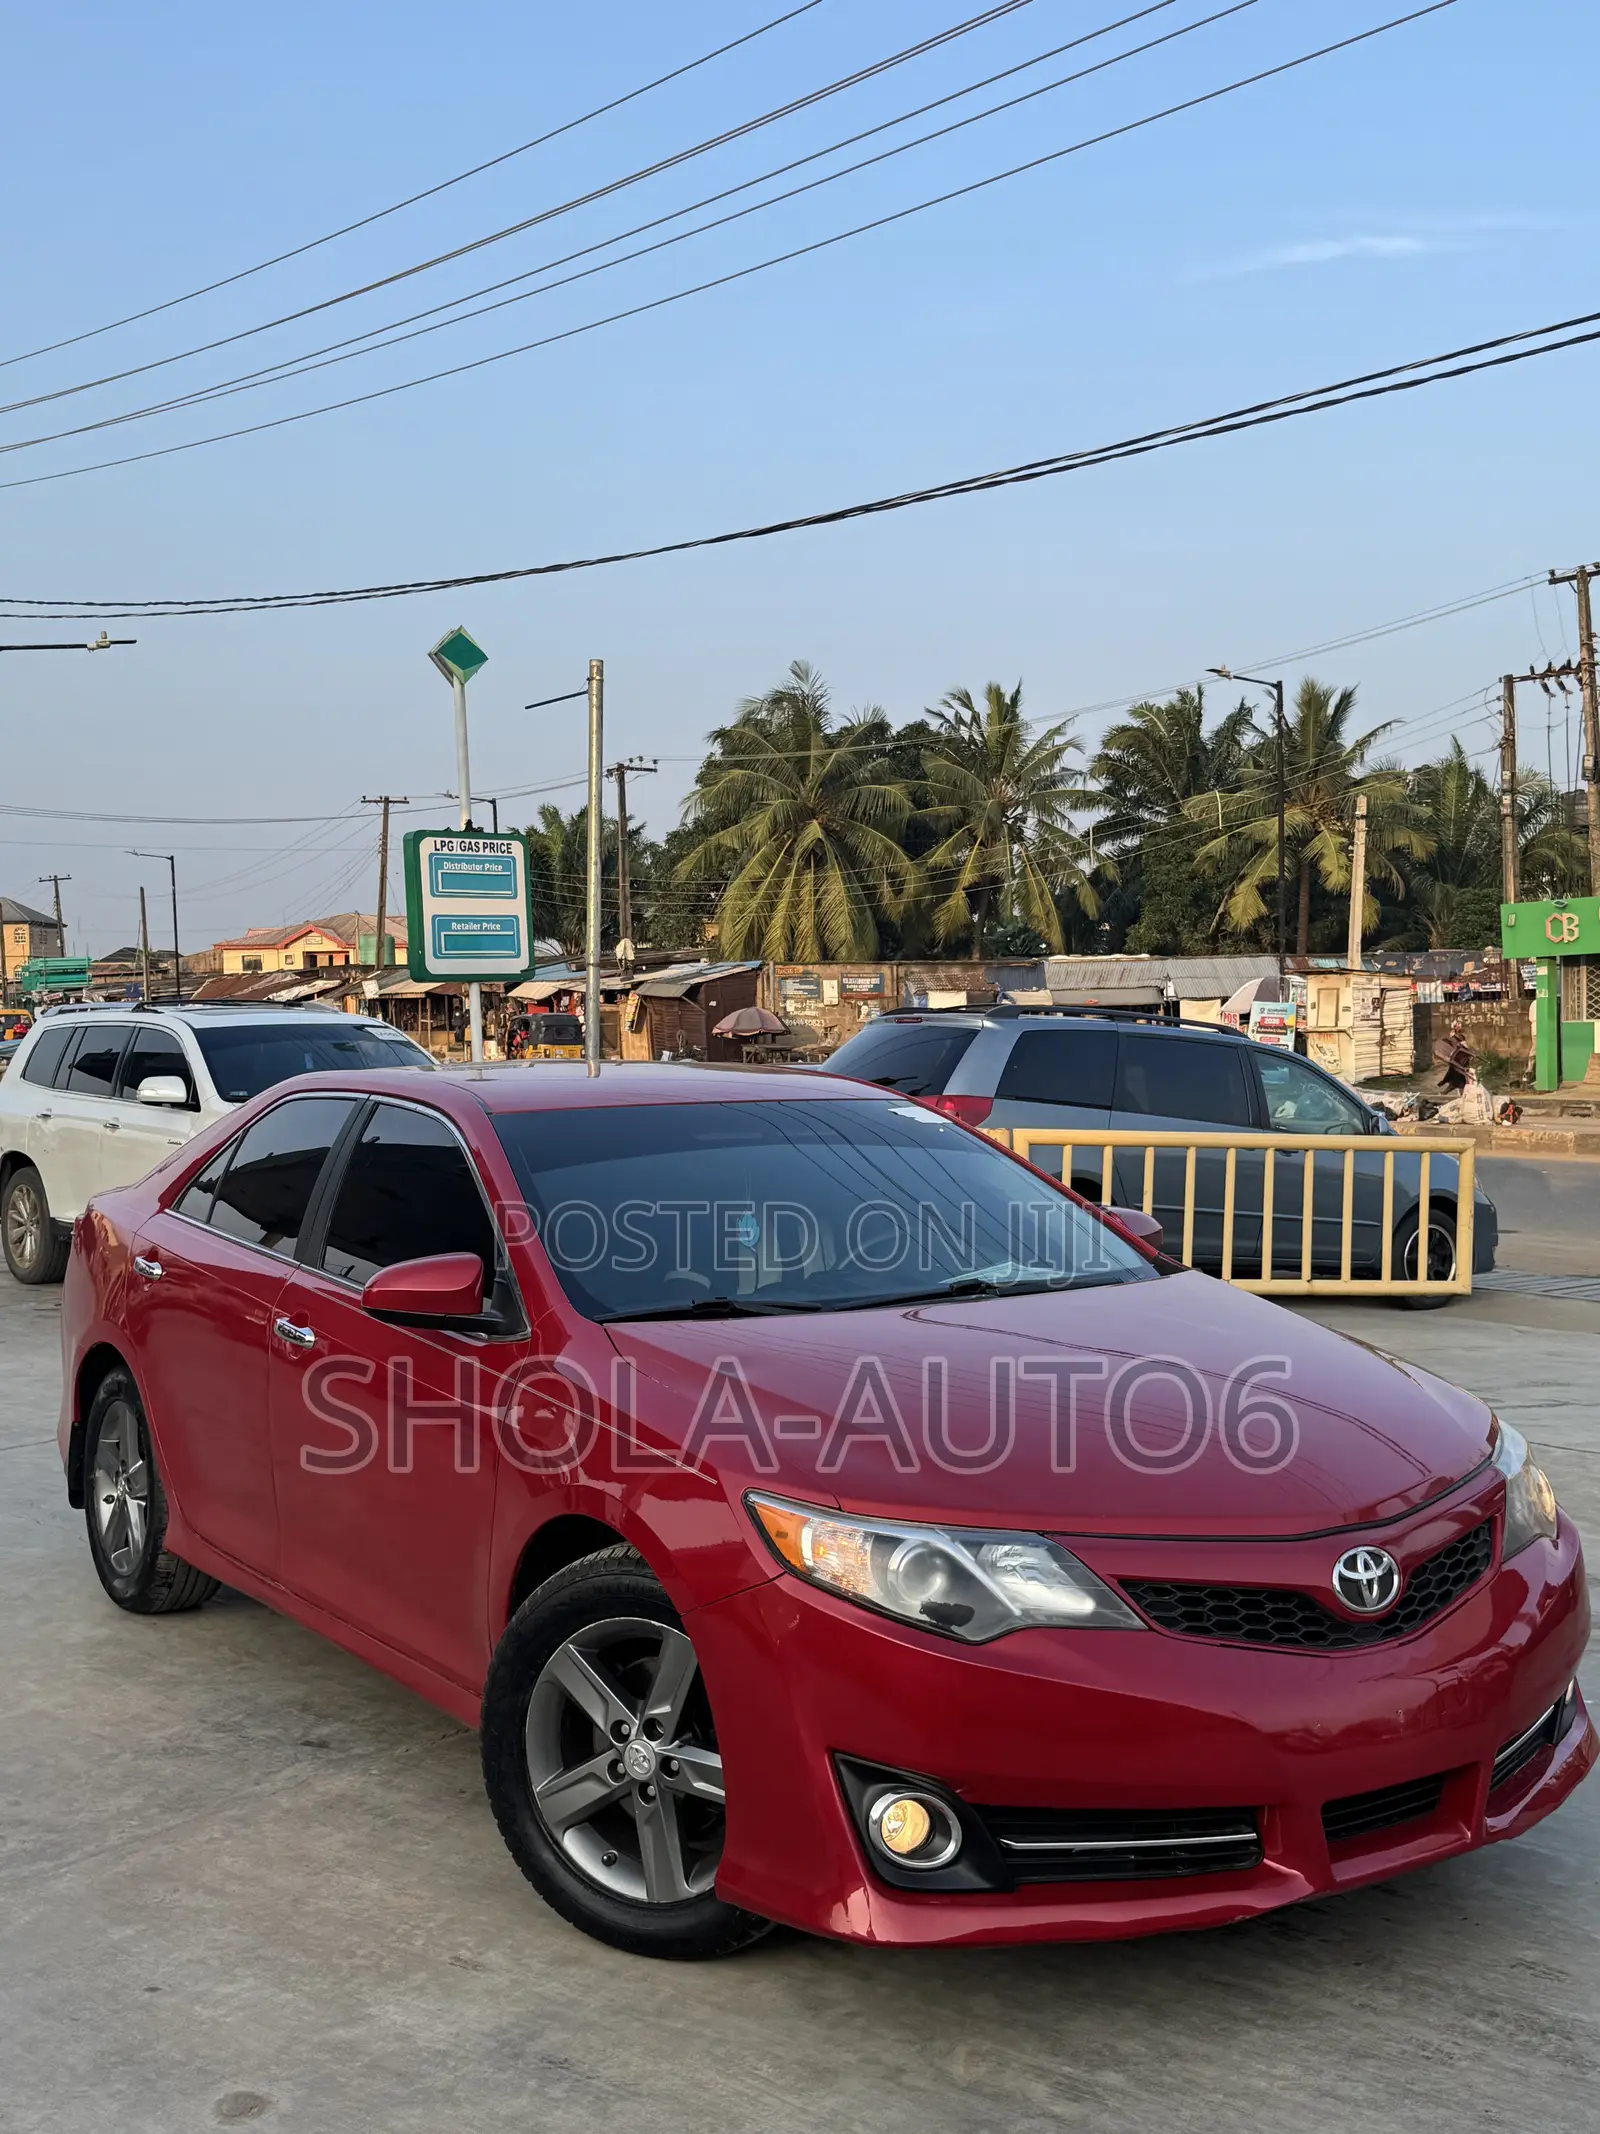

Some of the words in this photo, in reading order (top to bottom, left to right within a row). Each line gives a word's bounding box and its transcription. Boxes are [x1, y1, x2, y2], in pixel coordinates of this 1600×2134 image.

[482, 842, 513, 855] PRICE
[443, 861, 483, 871] Distributor
[484, 863, 503, 872] Price
[451, 922, 481, 931] Retailer
[482, 922, 501, 931] Price
[1223, 1012, 1239, 1025] POS
